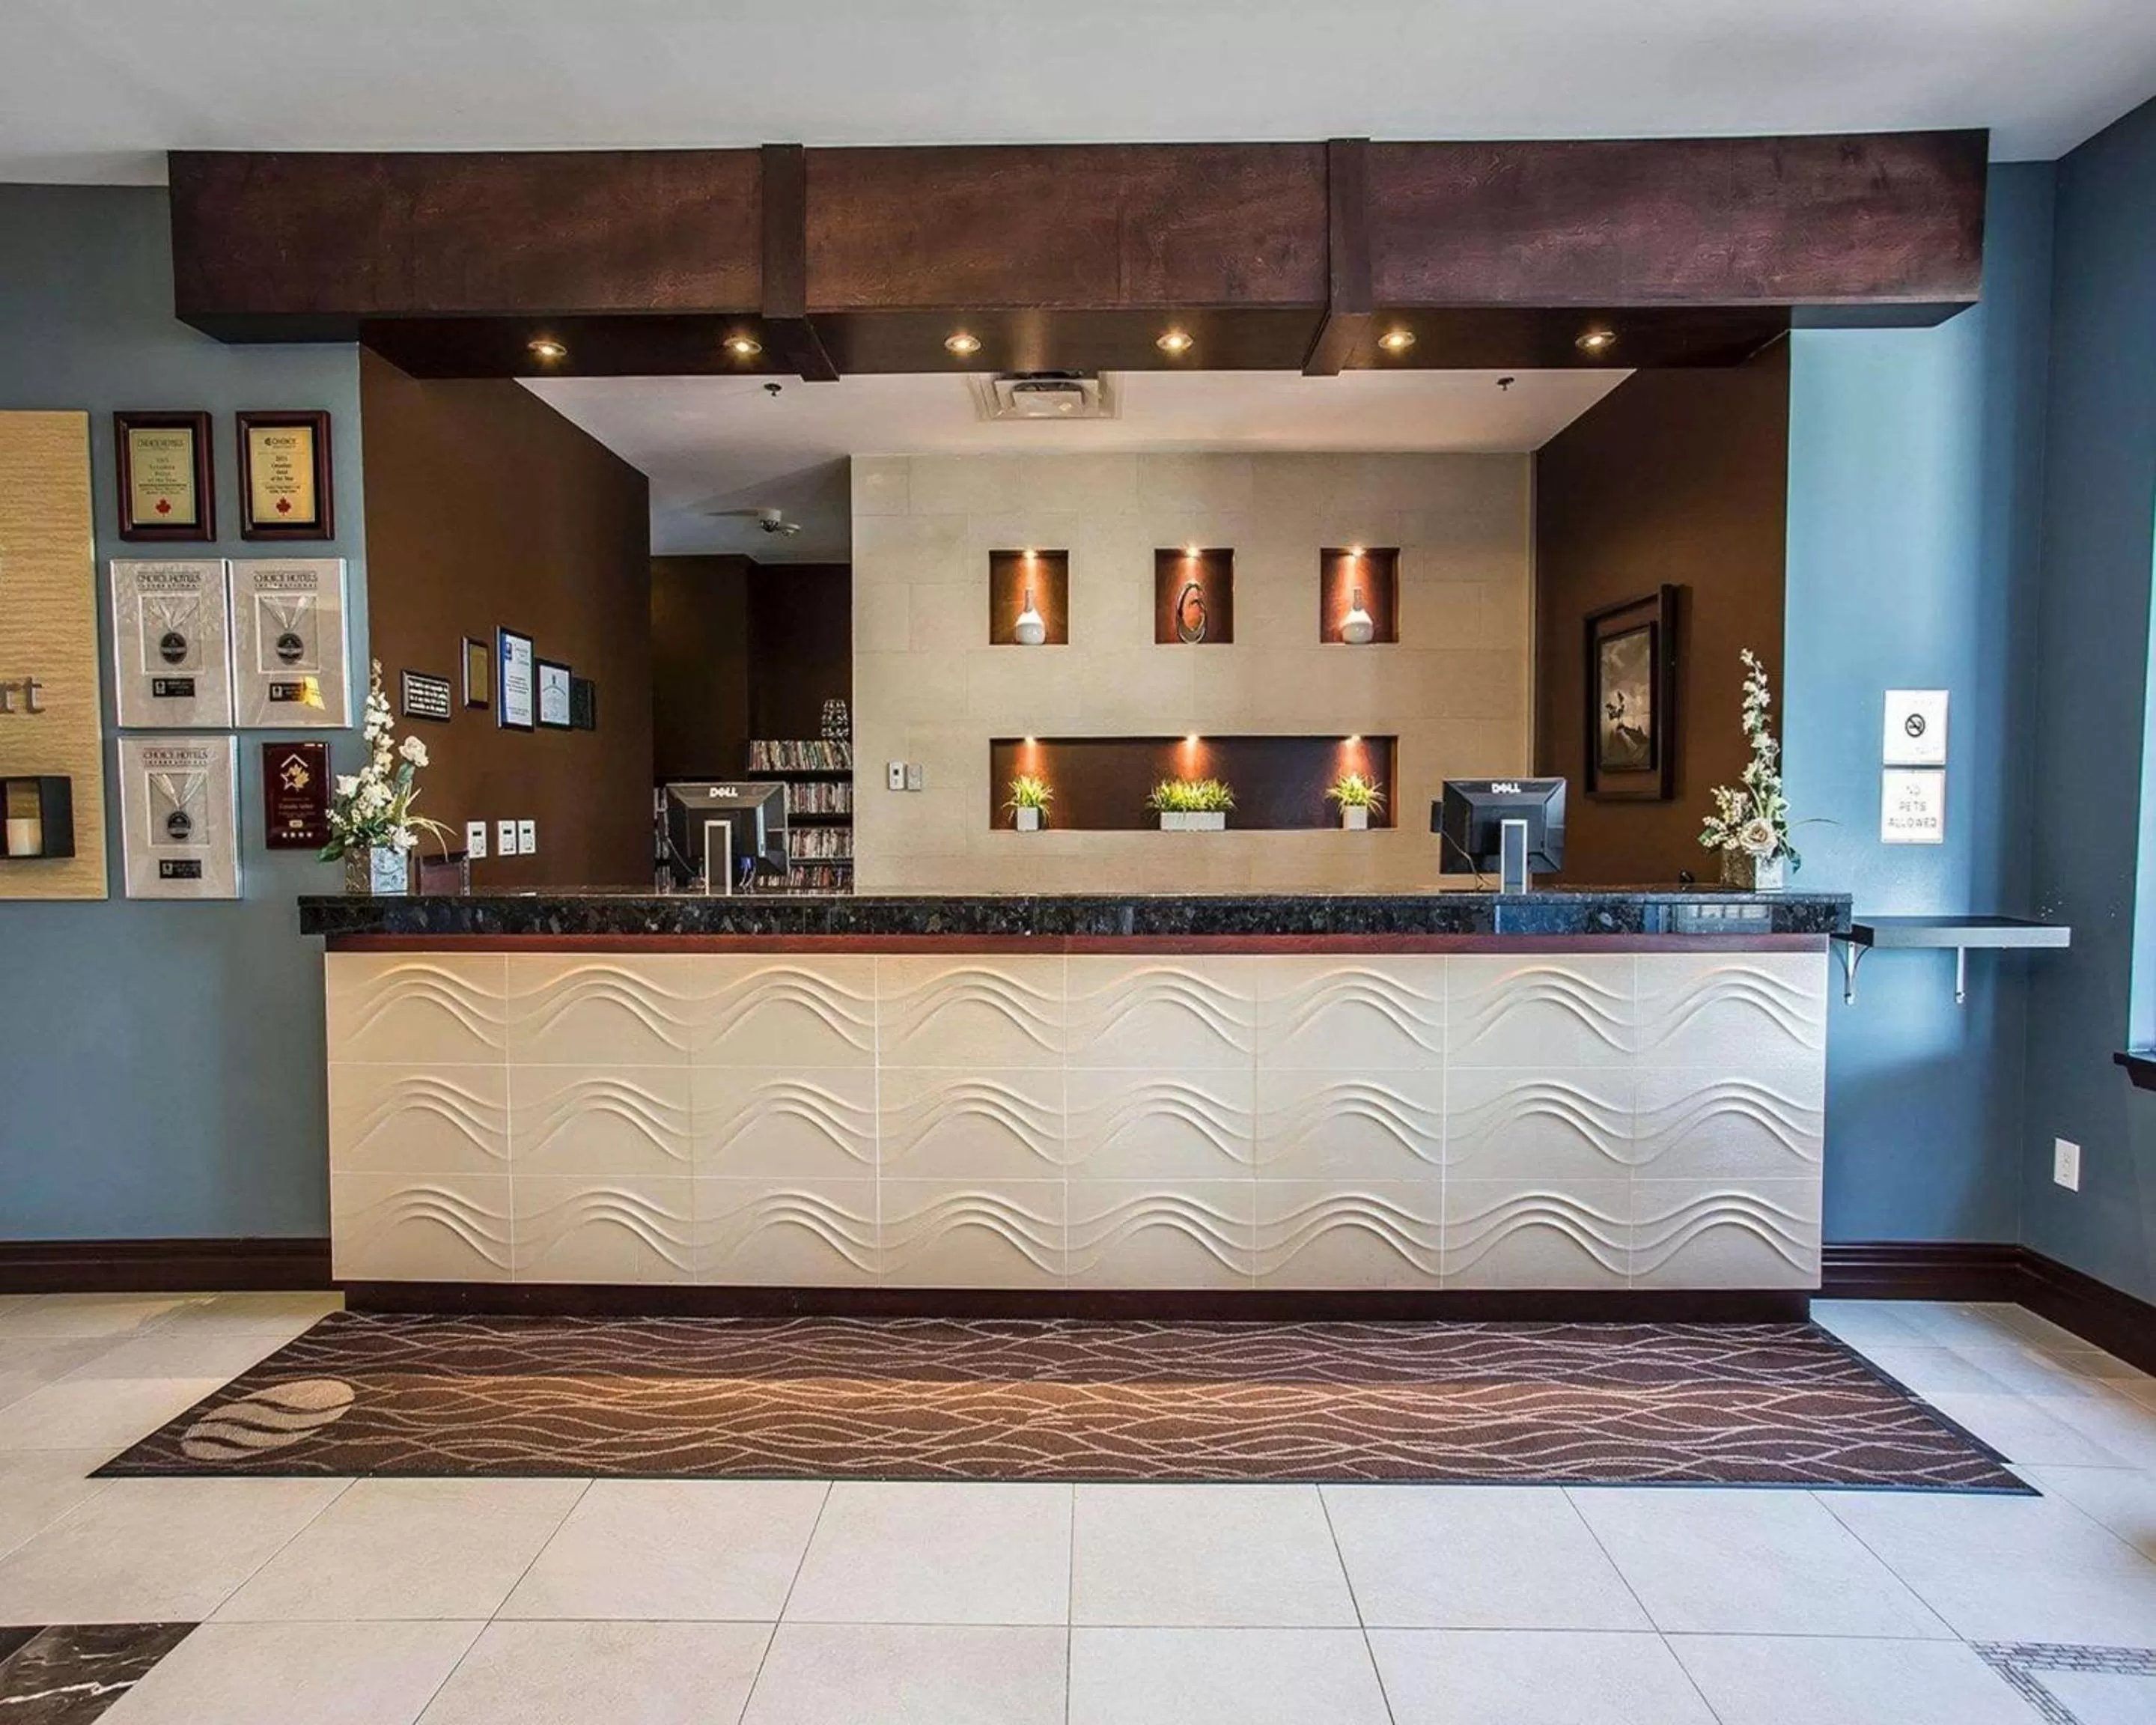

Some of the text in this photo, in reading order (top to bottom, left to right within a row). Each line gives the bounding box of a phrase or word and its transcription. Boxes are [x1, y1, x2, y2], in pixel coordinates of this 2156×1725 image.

[709, 787, 738, 797] DELL
[1491, 782, 1521, 793] DELL
[1898, 801, 1927, 812] PETS
[1887, 817, 1937, 828] ALLOWED
